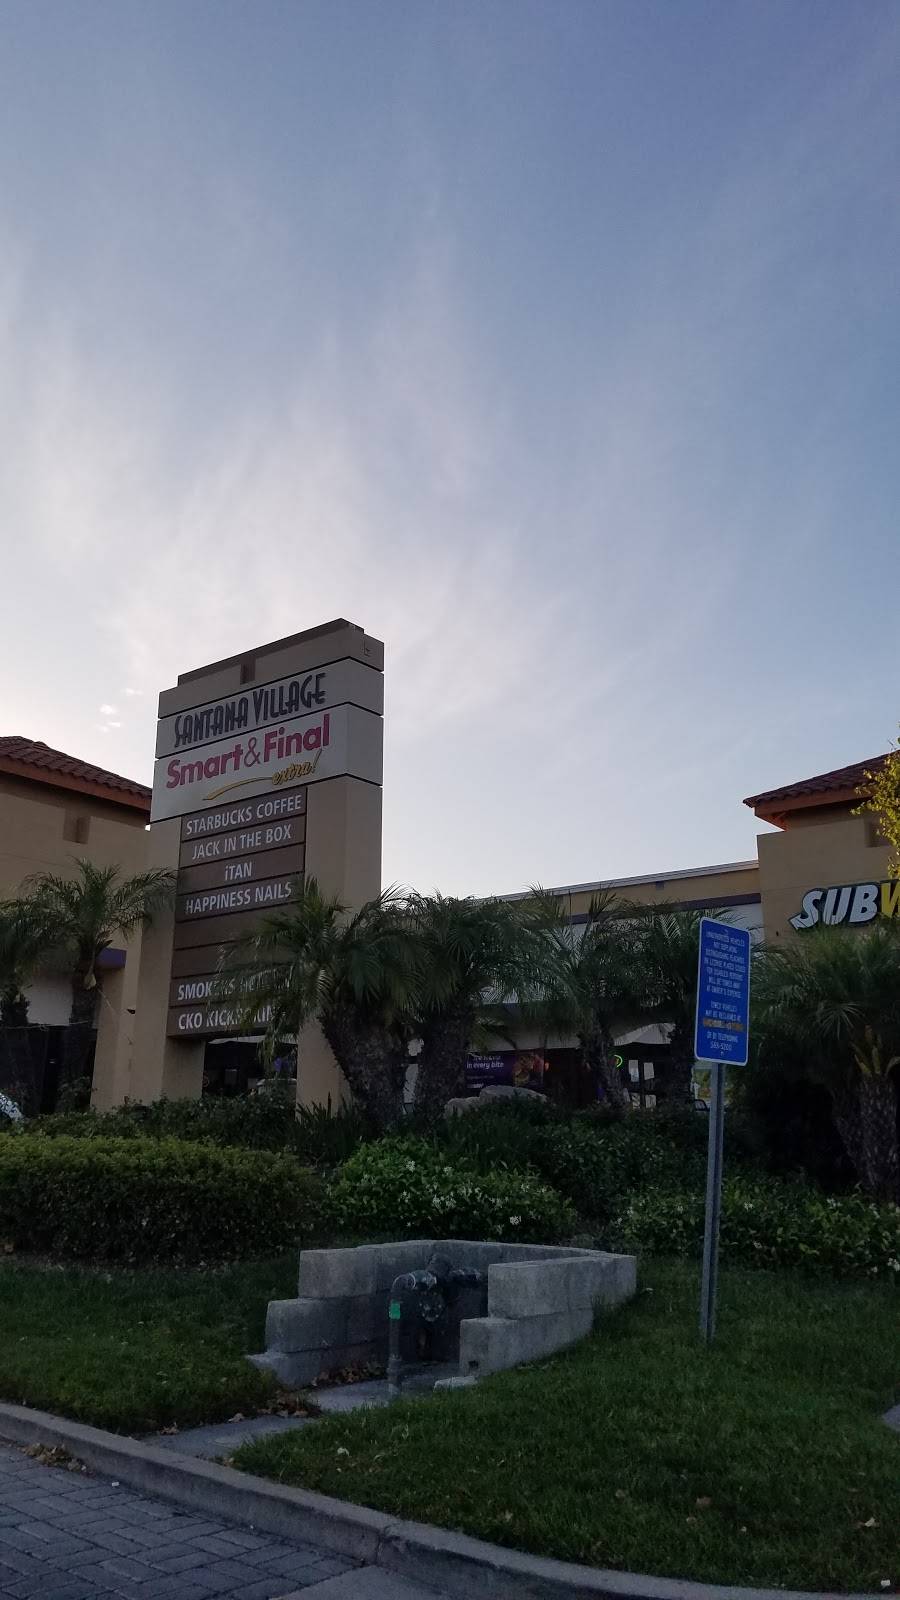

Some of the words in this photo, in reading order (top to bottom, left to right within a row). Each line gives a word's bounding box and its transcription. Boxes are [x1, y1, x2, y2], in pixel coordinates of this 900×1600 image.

[174, 697, 249, 748] SANTANA
[252, 672, 327, 725] VILLAGE
[186, 806, 252, 835] STARBUCKS
[256, 794, 302, 819] COFFEE
[192, 841, 221, 860] JACK
[223, 836, 238, 853] IN
[240, 831, 262, 849] THE
[265, 824, 291, 844] BOX
[185, 888, 251, 915] HAPPINESS
[255, 881, 292, 903] NAILS
[178, 1012, 203, 1030] CKO
[473, 1061, 490, 1070] every
